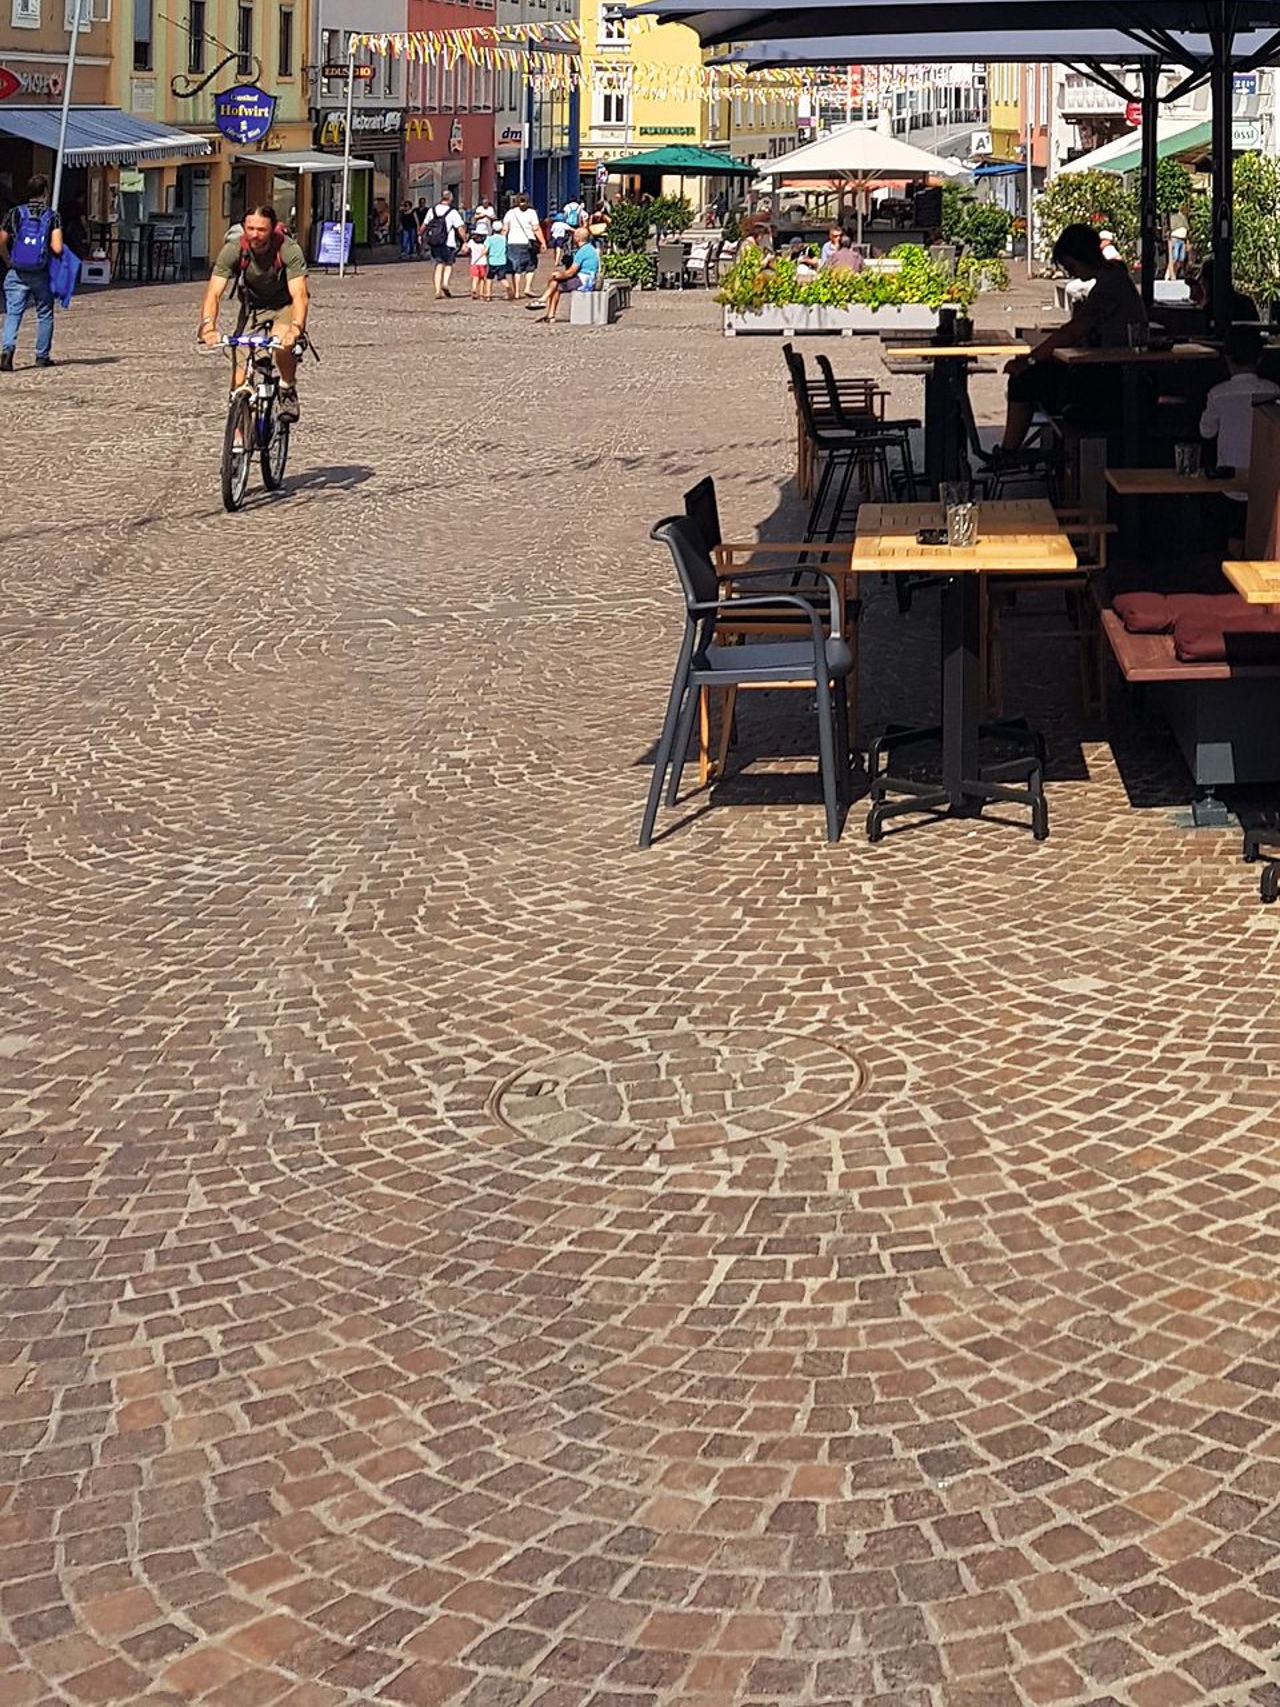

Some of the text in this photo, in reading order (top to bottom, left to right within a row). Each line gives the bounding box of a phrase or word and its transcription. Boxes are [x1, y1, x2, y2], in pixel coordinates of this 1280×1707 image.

[221, 105, 269, 117] Hofwirt
[502, 127, 521, 139] dm
[975, 135, 990, 150] A1
